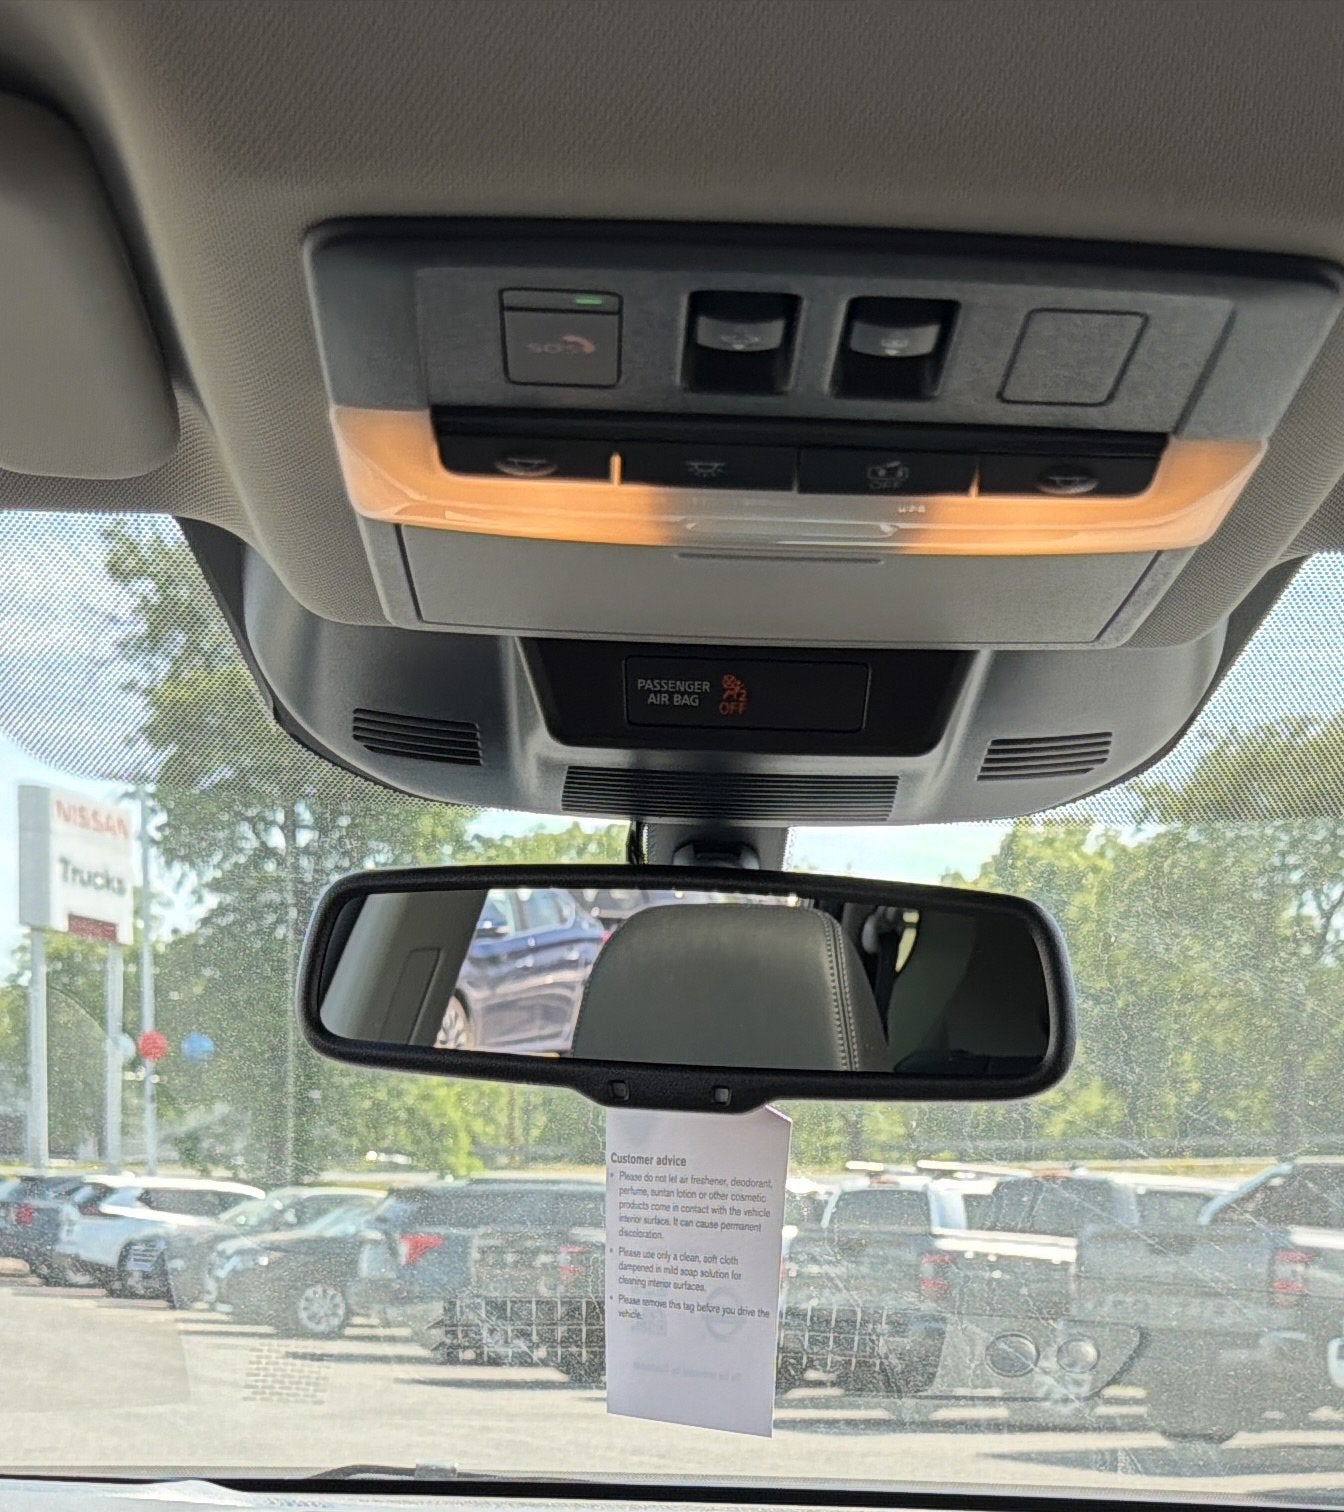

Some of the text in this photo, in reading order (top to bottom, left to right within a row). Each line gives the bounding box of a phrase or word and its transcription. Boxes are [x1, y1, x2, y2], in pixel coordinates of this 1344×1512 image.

[637, 679, 710, 692] PASSENGER
[647, 693, 699, 706] AIR BAG
[719, 702, 746, 715] OFF
[56, 800, 129, 839] NISSAN
[59, 857, 126, 895] Trucks
[611, 1152, 687, 1167] Customer advice
